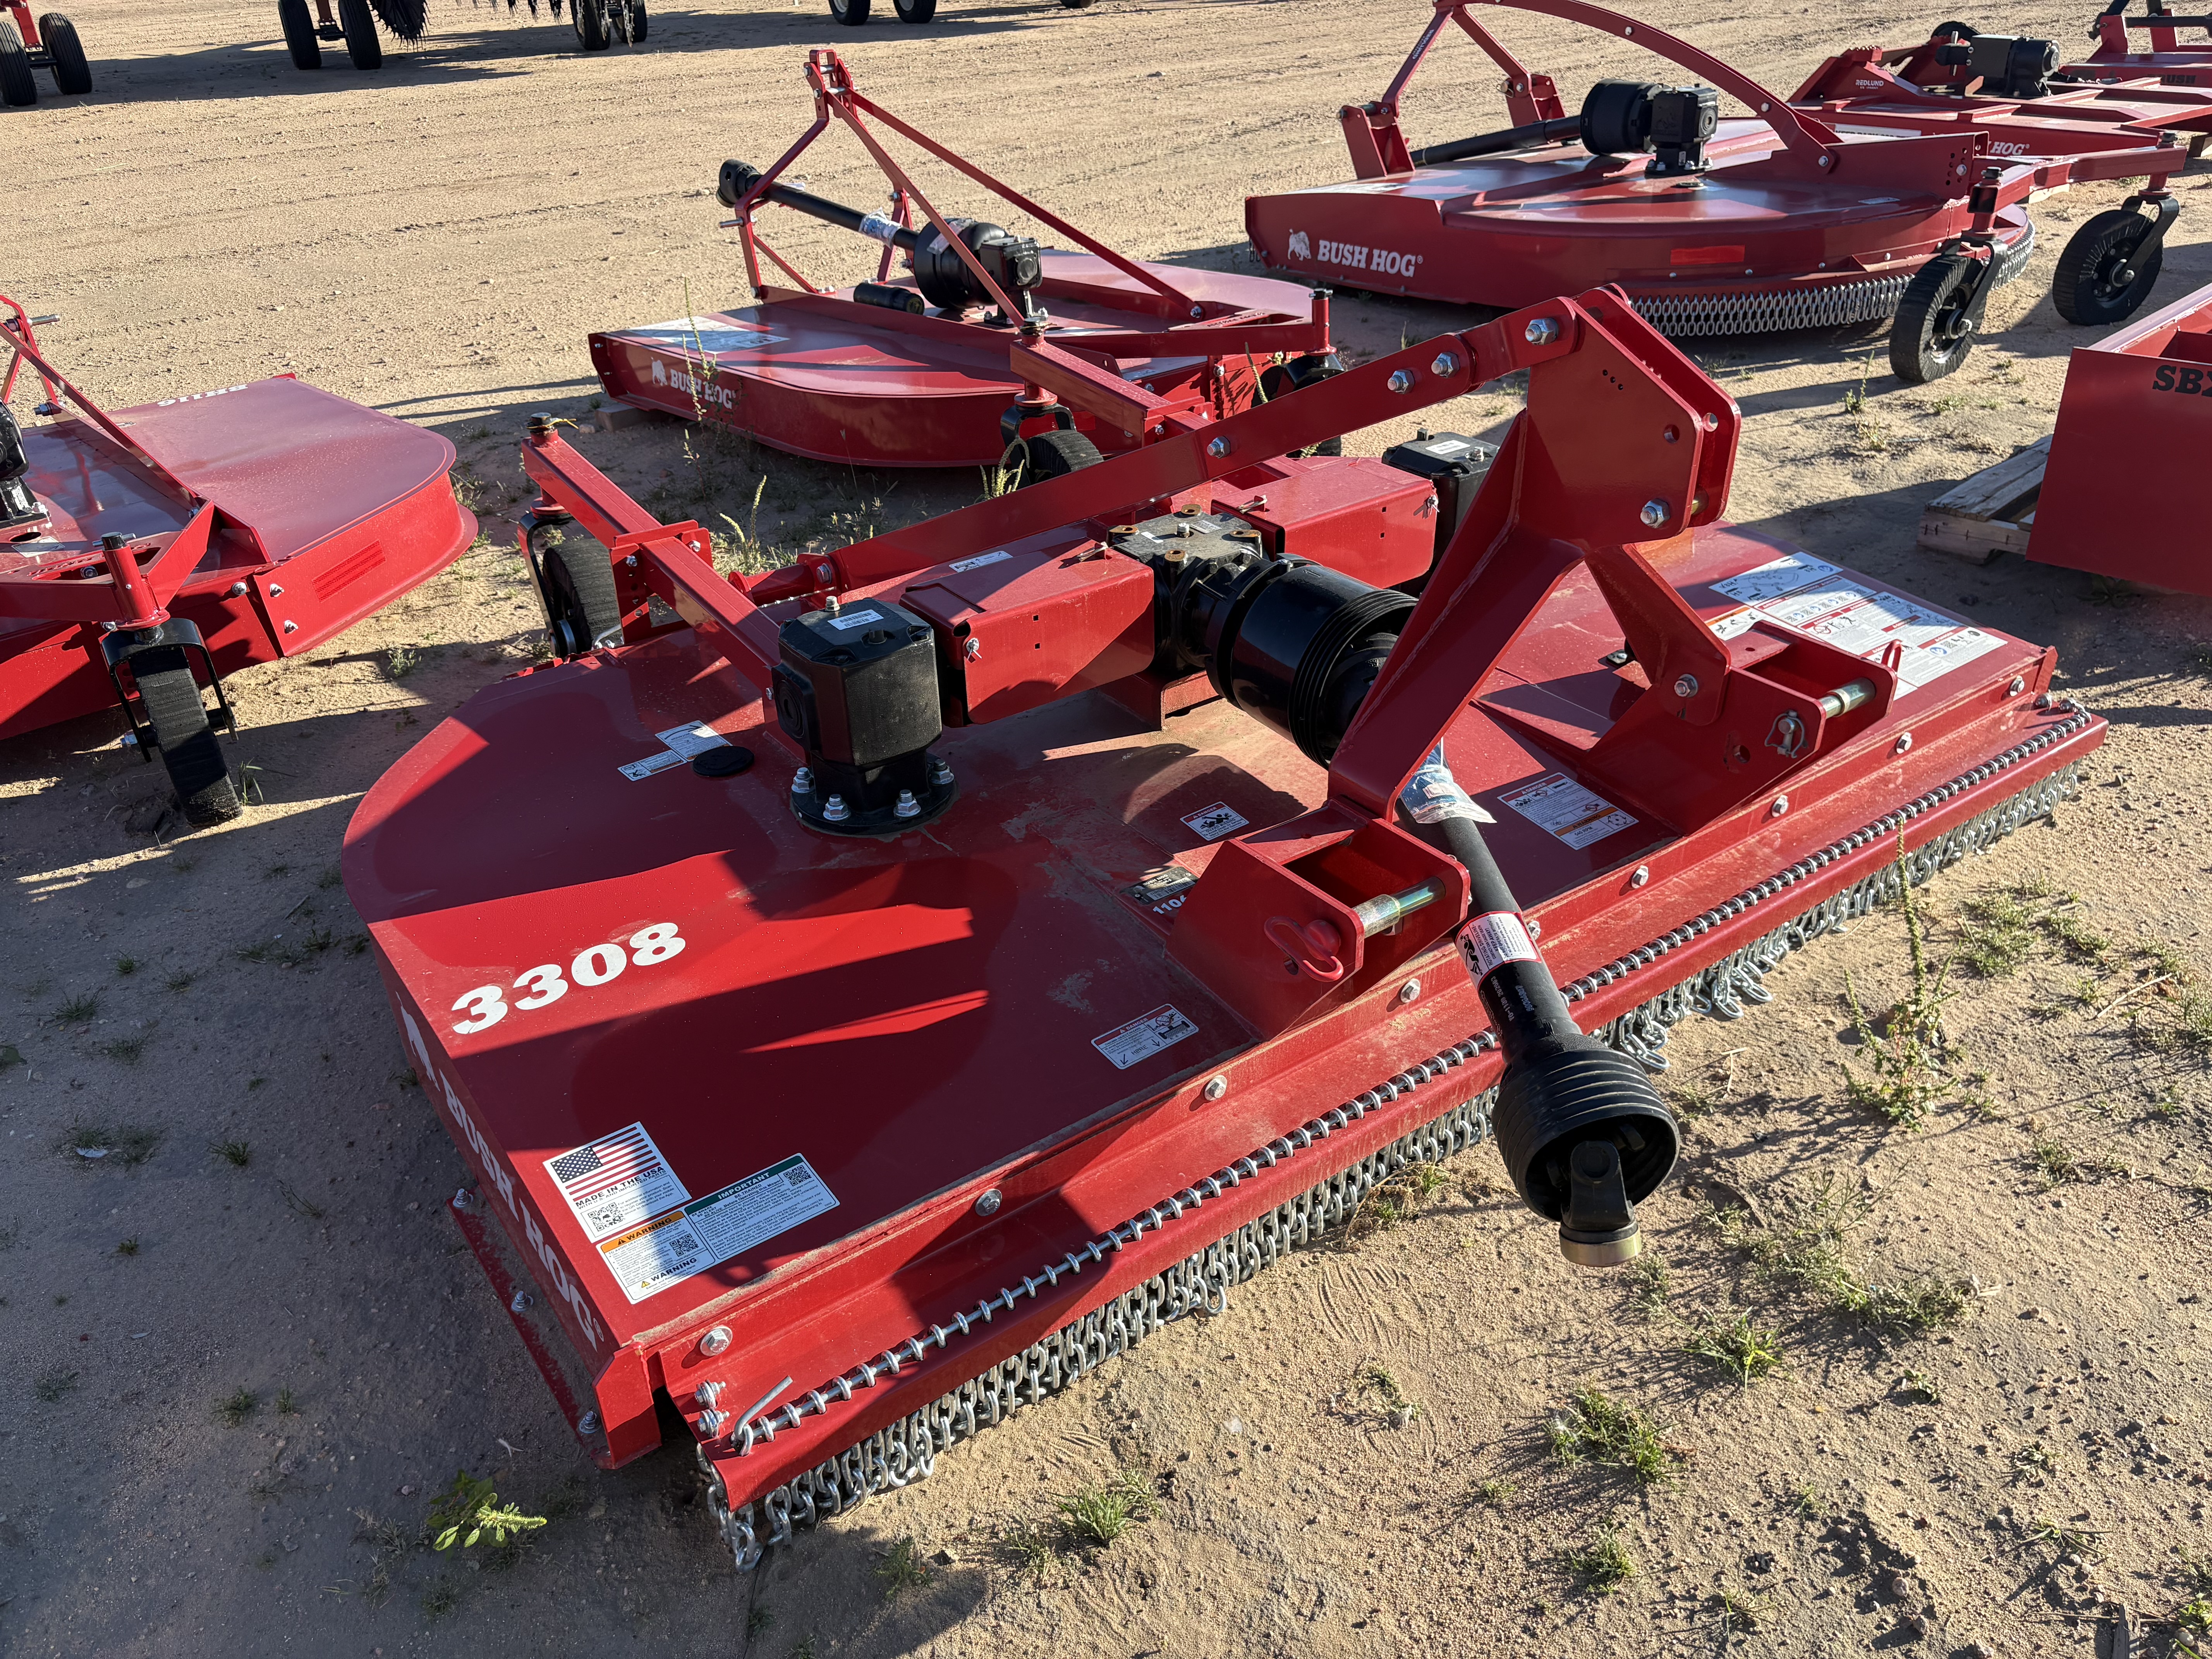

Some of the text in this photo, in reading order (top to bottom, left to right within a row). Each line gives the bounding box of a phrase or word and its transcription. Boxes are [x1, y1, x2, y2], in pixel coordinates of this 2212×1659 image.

[1317, 240, 1416, 278] BUSH HOG
[670, 368, 702, 398] BUSH
[1525, 782, 1547, 792] DANGER
[1197, 807, 1217, 816] DANGER
[1575, 814, 1601, 826] WARNING
[1484, 927, 1499, 951] KEEP AWAY!
[1494, 932, 1503, 946] OPERATE
[1480, 946, 1493, 966] ROTATING
[1488, 947, 1496, 959] CONTACT
[450, 922, 686, 1034] 3308
[1125, 1017, 1149, 1030] DANGER
[1130, 1044, 1148, 1055] HERE
[575, 1191, 605, 1207] MADE
[606, 1185, 618, 1194] IN
[620, 1175, 642, 1188] THE
[642, 1166, 664, 1178] USA
[578, 1202, 592, 1210] WITH
[618, 1178, 647, 1192] IMPORTED
[648, 1170, 666, 1179] PARTS
[624, 1193, 643, 1202] additional
[642, 1184, 663, 1195] information
[717, 1171, 771, 1200] IMPORTANT
[723, 1199, 738, 1207] Before
[737, 1189, 759, 1201] Operating
[767, 1179, 781, 1187] Mower
[741, 1183, 762, 1195] TRAINED
[439, 1068, 598, 1352] BUSH HOG
[641, 1198, 659, 1208] download
[697, 1206, 712, 1214] AWARE
[703, 1206, 717, 1214] ALERT
[626, 1217, 673, 1240] WARNING
[648, 1227, 666, 1237] SERIOUS
[650, 1257, 697, 1282] WARNING
[665, 1269, 687, 1280] Reproductive
